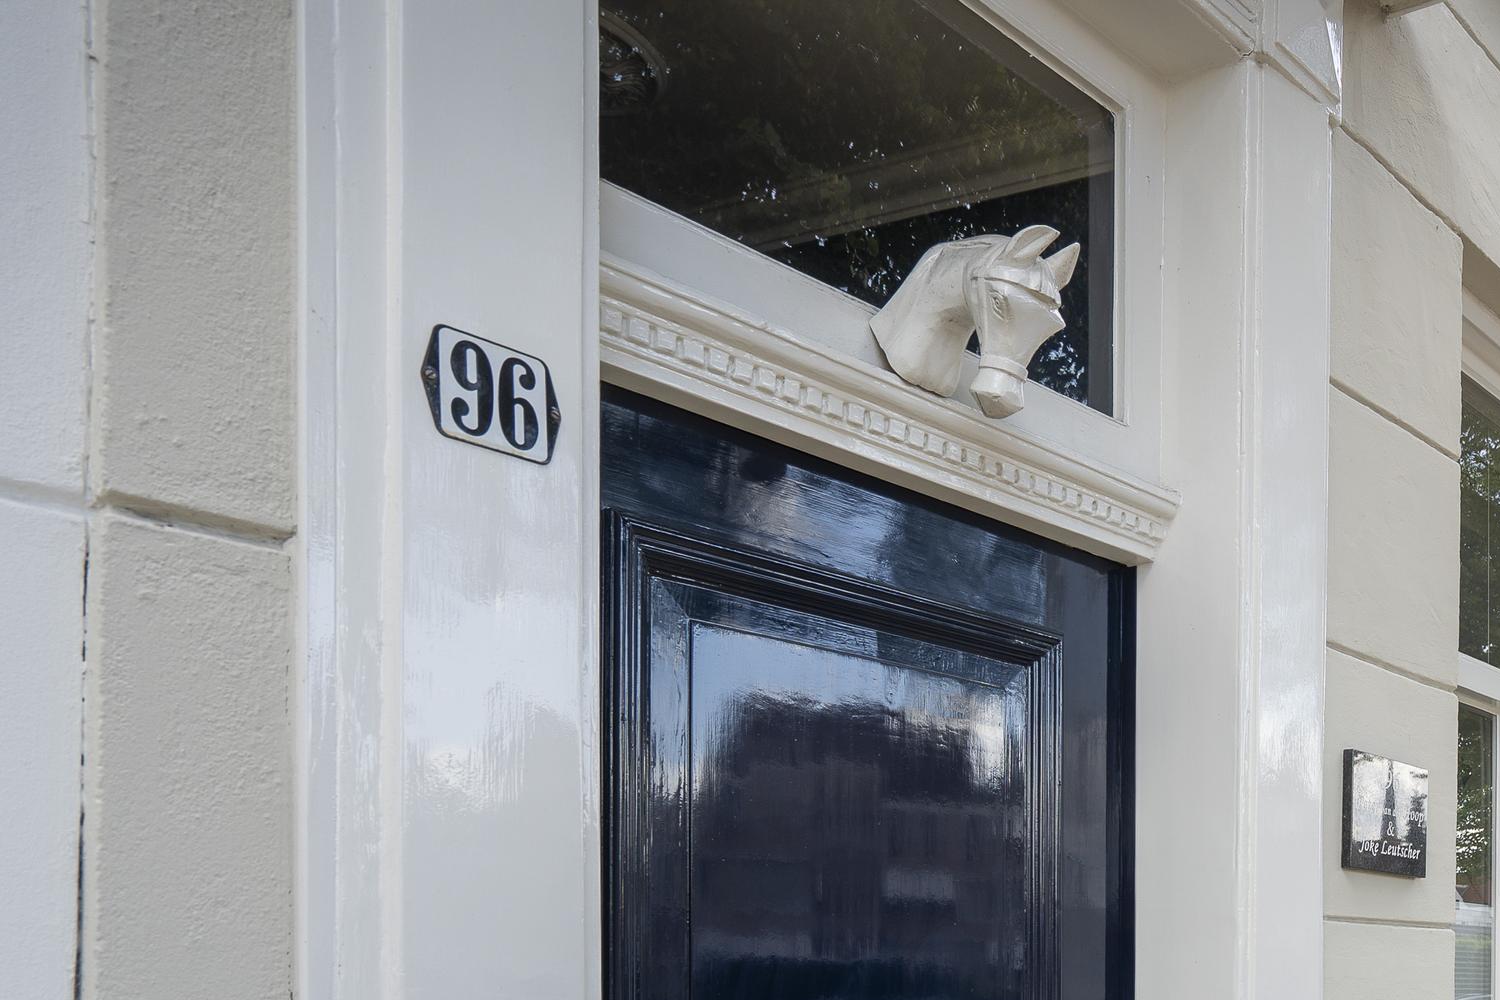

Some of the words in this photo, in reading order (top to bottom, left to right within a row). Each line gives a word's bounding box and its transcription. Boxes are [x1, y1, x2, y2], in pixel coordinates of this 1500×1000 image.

[450, 339, 539, 451] 96
[1386, 821, 1395, 837] &
[1358, 839, 1379, 857] Joke
[1380, 840, 1421, 860] Leutscher
